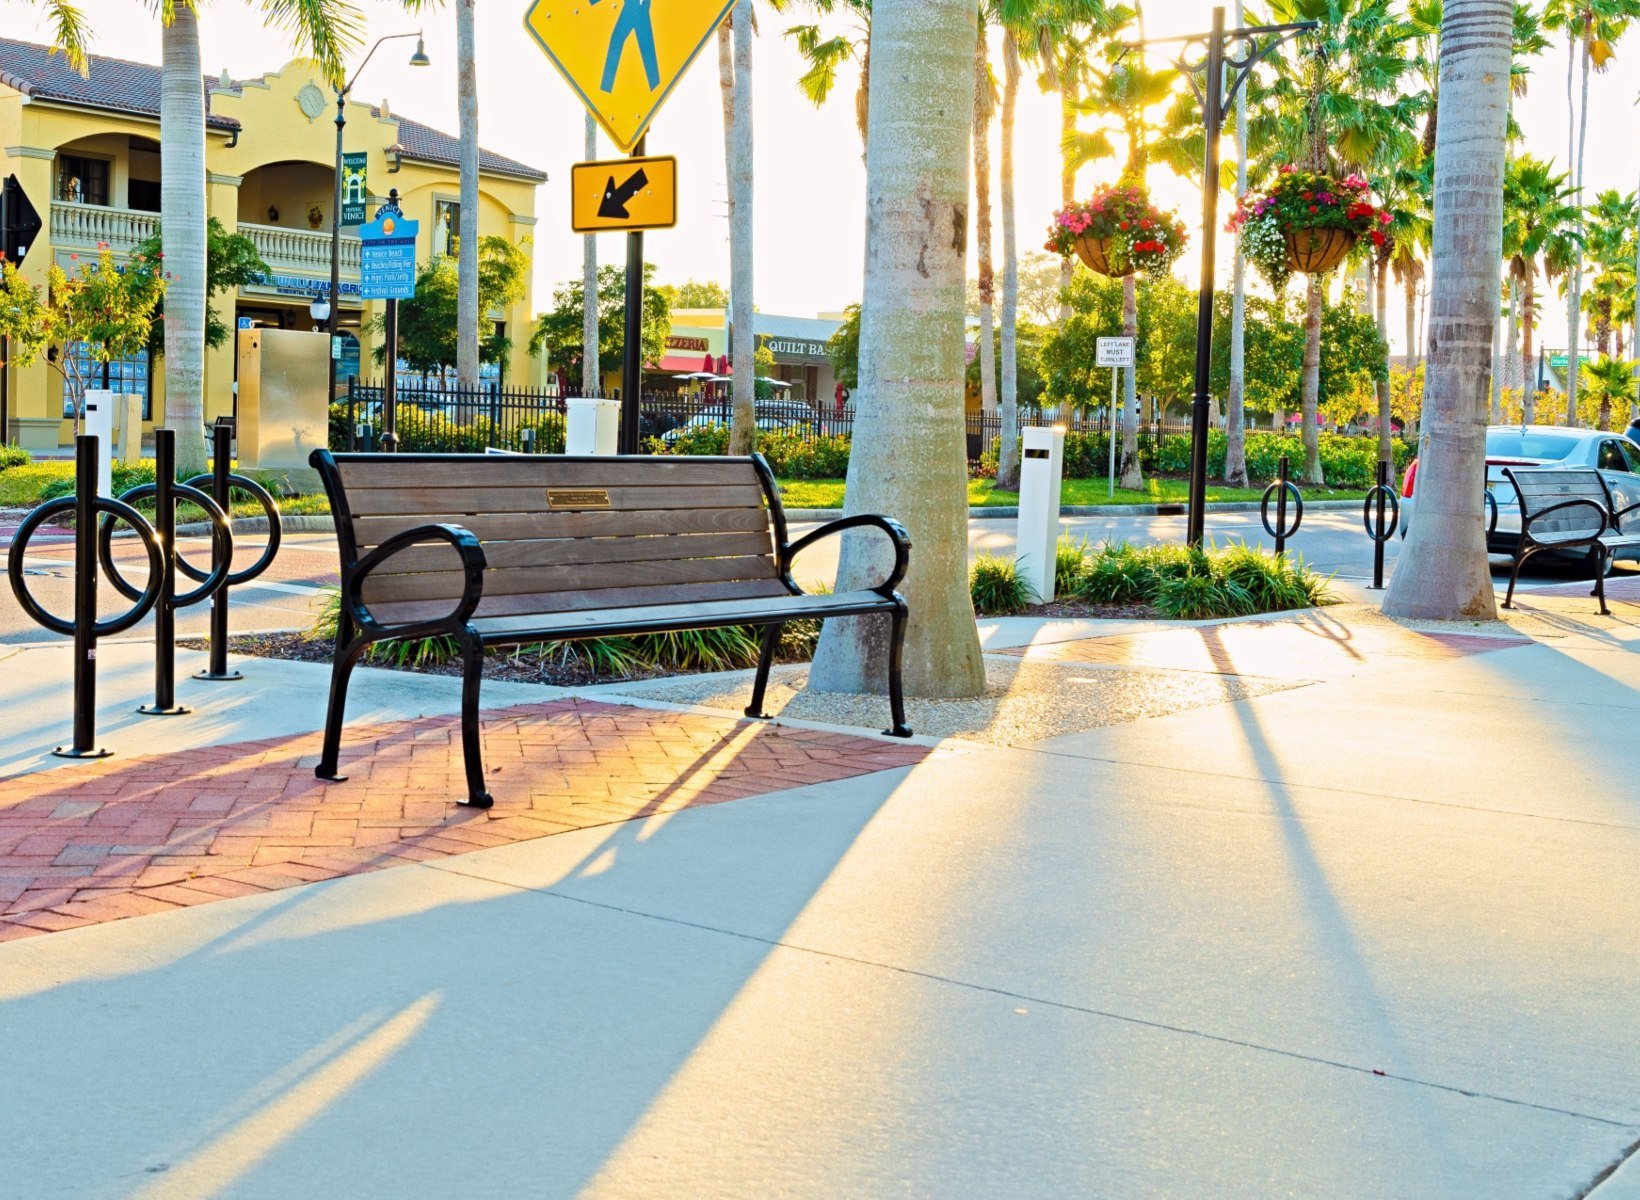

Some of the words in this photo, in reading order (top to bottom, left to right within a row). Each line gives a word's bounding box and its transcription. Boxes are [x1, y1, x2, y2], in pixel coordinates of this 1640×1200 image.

[343, 157, 367, 165] WELCOME
[377, 204, 401, 216] VENICE
[343, 212, 365, 220] VENICE
[372, 250, 387, 258] Venice
[388, 249, 403, 257] Beach
[371, 286, 388, 294] Festival
[389, 286, 409, 294] Grounds
[768, 340, 807, 354] QUILT
